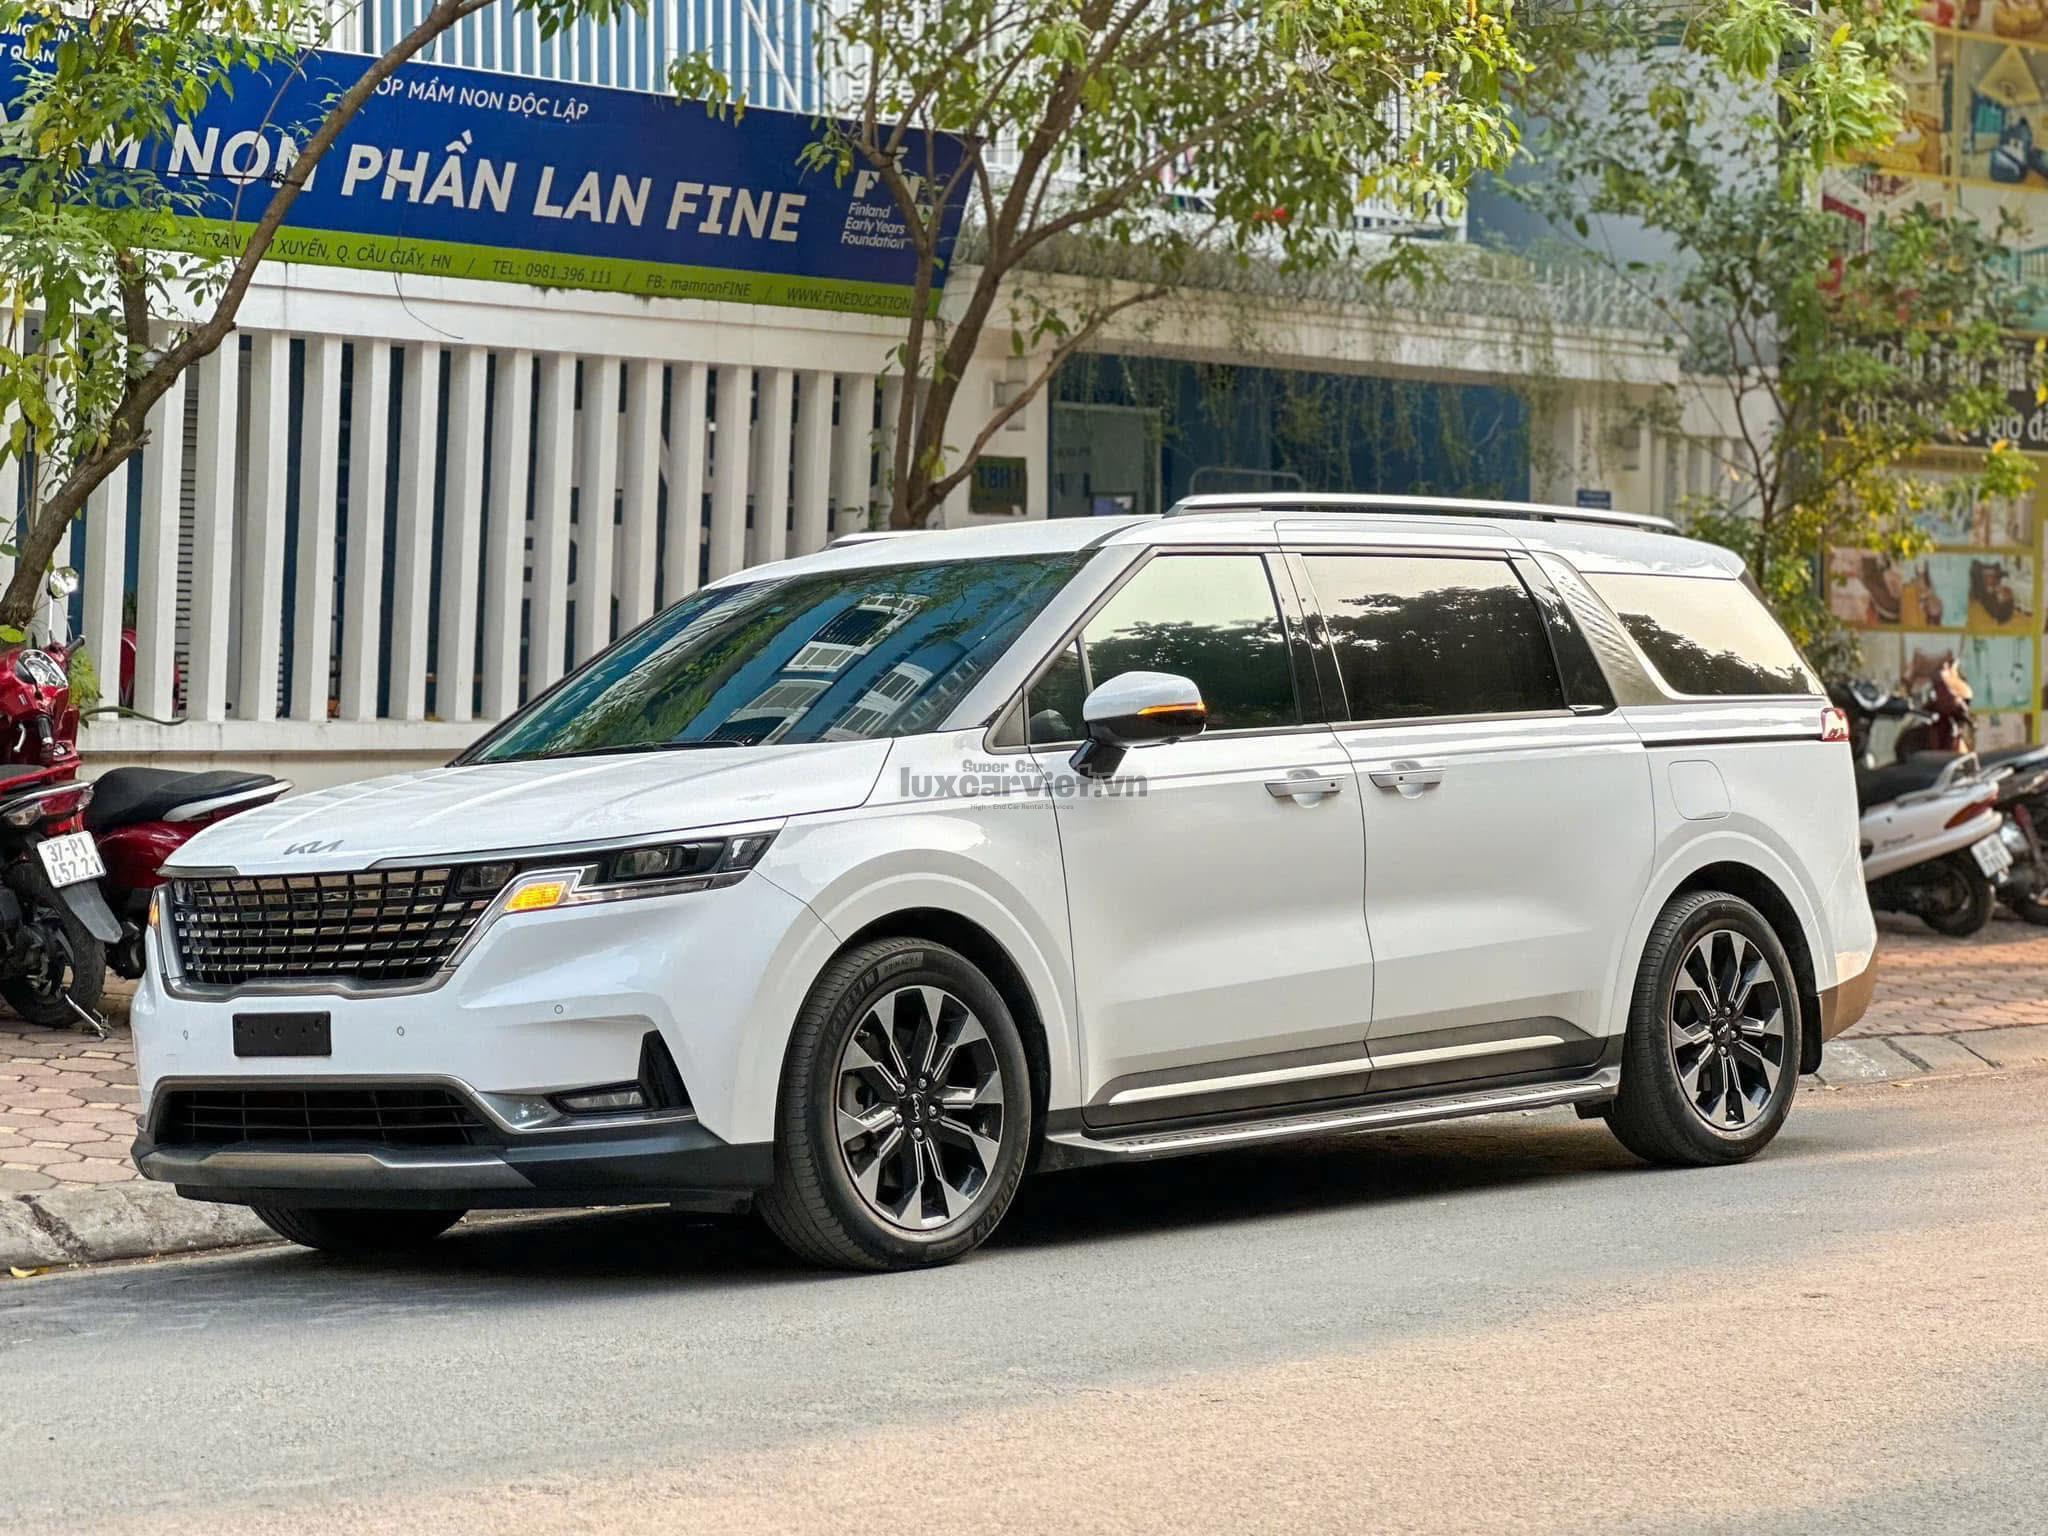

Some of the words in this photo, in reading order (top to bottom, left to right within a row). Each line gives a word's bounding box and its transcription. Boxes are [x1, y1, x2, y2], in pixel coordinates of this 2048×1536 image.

[370, 75, 404, 96] ỚP
[408, 76, 454, 103] MẦM
[459, 87, 504, 110] NON
[508, 92, 549, 118] ĐỘC
[552, 97, 589, 123] LẬP
[341, 129, 517, 213] PHẦN
[533, 166, 653, 227] LAN
[666, 181, 807, 242] FINE
[848, 202, 891, 218] Finland
[845, 217, 875, 233] Early
[875, 220, 906, 235] Years
[841, 231, 905, 249] Foundation
[336, 244, 350, 262] Q.
[430, 254, 452, 269] HN
[492, 259, 521, 276] TEL:
[525, 262, 612, 284] 0981.396.111
[646, 274, 667, 289] FB:
[670, 278, 752, 297] mamnonFINE
[46, 838, 88, 862] 37-P1
